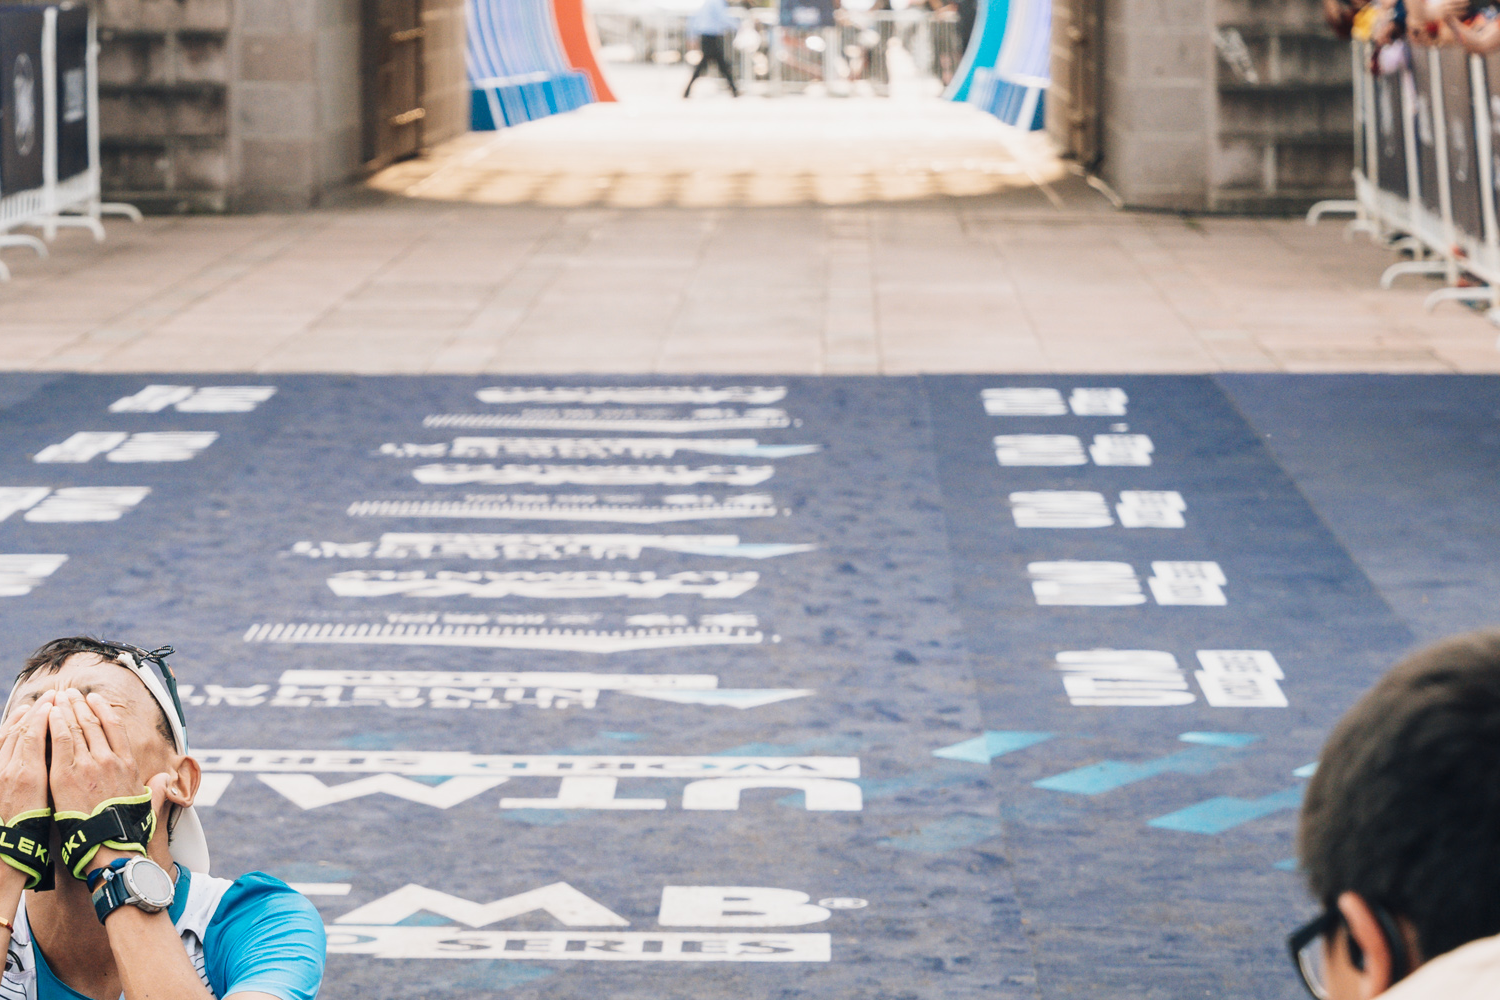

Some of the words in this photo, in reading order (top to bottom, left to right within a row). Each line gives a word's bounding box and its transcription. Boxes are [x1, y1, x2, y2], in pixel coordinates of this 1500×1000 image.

[194, 773, 864, 812] UTM
[61, 830, 87, 865] EKI
[439, 937, 794, 955] SERIES
